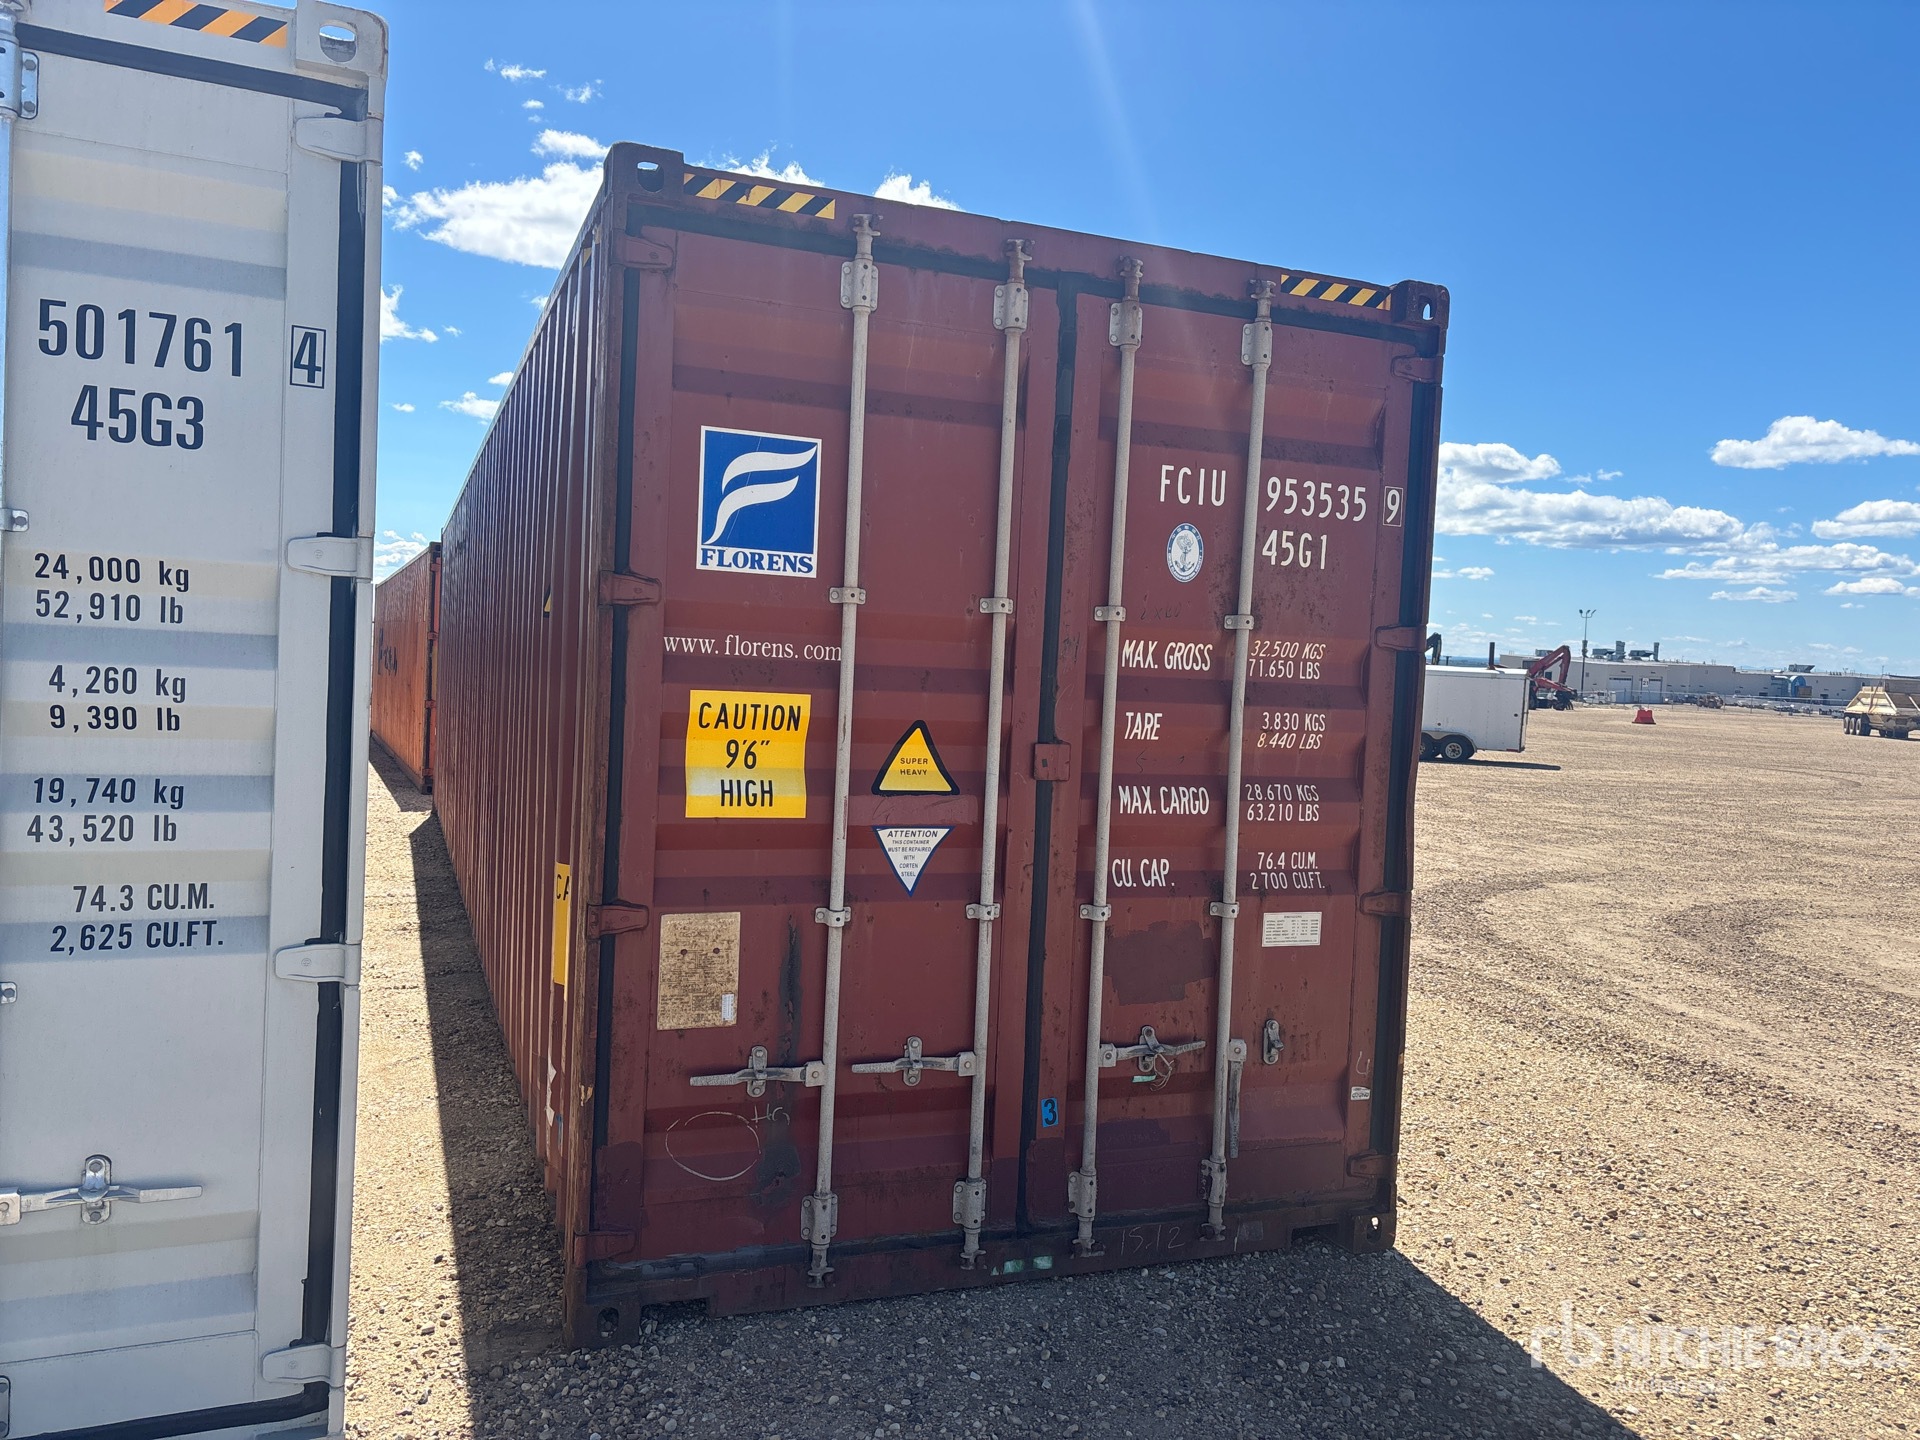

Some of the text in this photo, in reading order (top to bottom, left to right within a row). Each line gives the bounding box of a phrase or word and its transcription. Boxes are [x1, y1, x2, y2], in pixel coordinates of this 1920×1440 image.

[38, 298, 322, 383] 501761 4
[71, 385, 204, 450] 45G3
[1160, 464, 1400, 523] FCIU 953535 9
[700, 548, 813, 573] FLORENS
[1262, 530, 1328, 569] 45G1
[34, 553, 190, 593] 24,000 kg
[36, 589, 184, 624] 52,910 lb
[1121, 639, 1213, 672] MAX. GROSS
[1301, 642, 1326, 660] KGS
[1249, 658, 1320, 680] 71,650 LBS
[49, 665, 187, 703] 4,260 kg
[50, 704, 181, 733] 9,390 lb
[698, 702, 801, 731] CAUTION
[1124, 711, 1163, 741] TARE
[1304, 713, 1326, 732] KGS
[1298, 733, 1323, 750] LBS
[900, 757, 928, 765] SUPER
[900, 768, 927, 776] HEAVY
[33, 777, 185, 810] 19,740 kg
[720, 779, 774, 807] HIGH
[1118, 785, 1210, 815] MAX. CARGO
[1295, 784, 1320, 802] KGS
[1247, 803, 1320, 822] 63,210 LBS
[27, 814, 178, 847] 43,520 lb
[887, 830, 938, 838] ATTENTION
[1112, 858, 1175, 888] CU. CAP.
[1257, 851, 1318, 870] 76.4 CU.M.
[1292, 871, 1325, 889] CU.FT.
[73, 883, 215, 912] 74.3 CU.M.
[50, 921, 223, 955] 2,625 CU.FT.
[1044, 1098, 1057, 1126] 3
